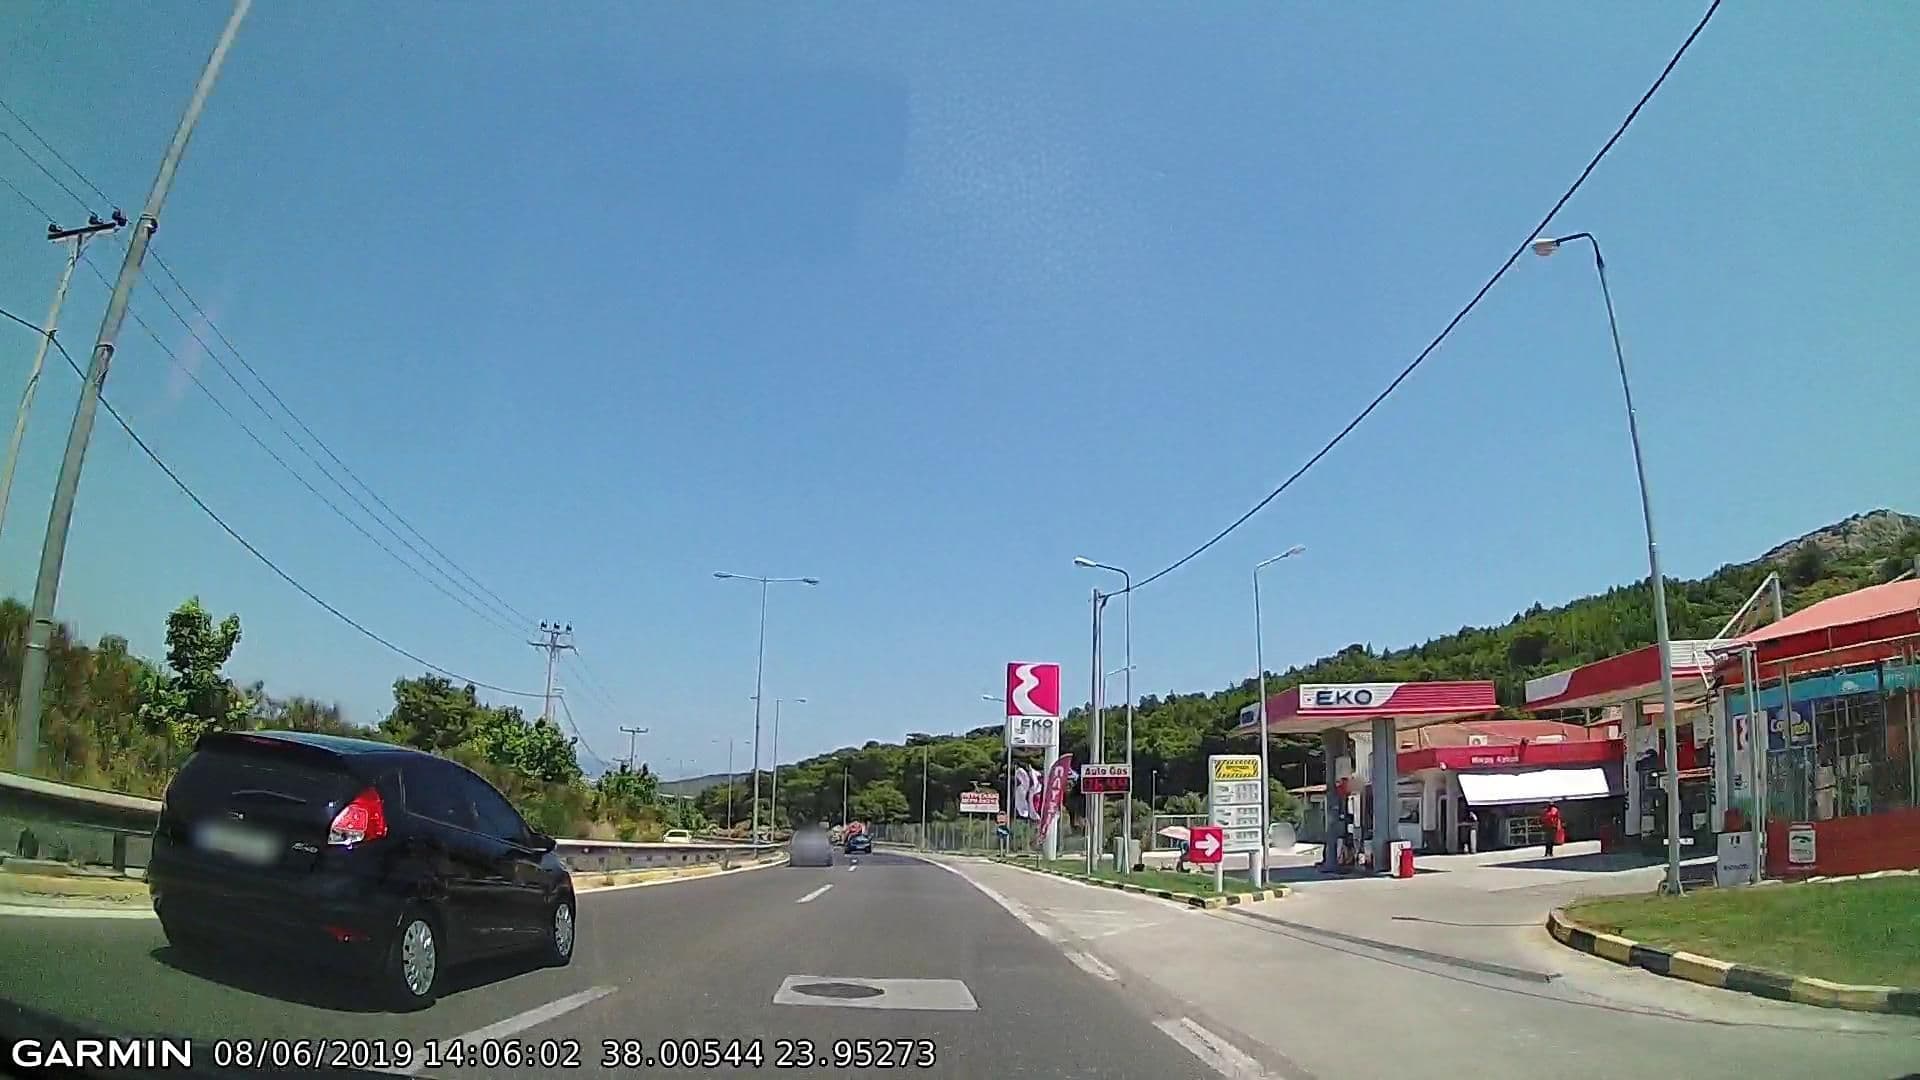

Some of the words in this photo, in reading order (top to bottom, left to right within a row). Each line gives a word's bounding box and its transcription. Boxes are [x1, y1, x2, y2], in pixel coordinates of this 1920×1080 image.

[1316, 688, 1373, 706] EKO
[1021, 718, 1053, 729] EKO
[1085, 767, 1106, 776] Auto
[1109, 767, 1128, 776] Gas
